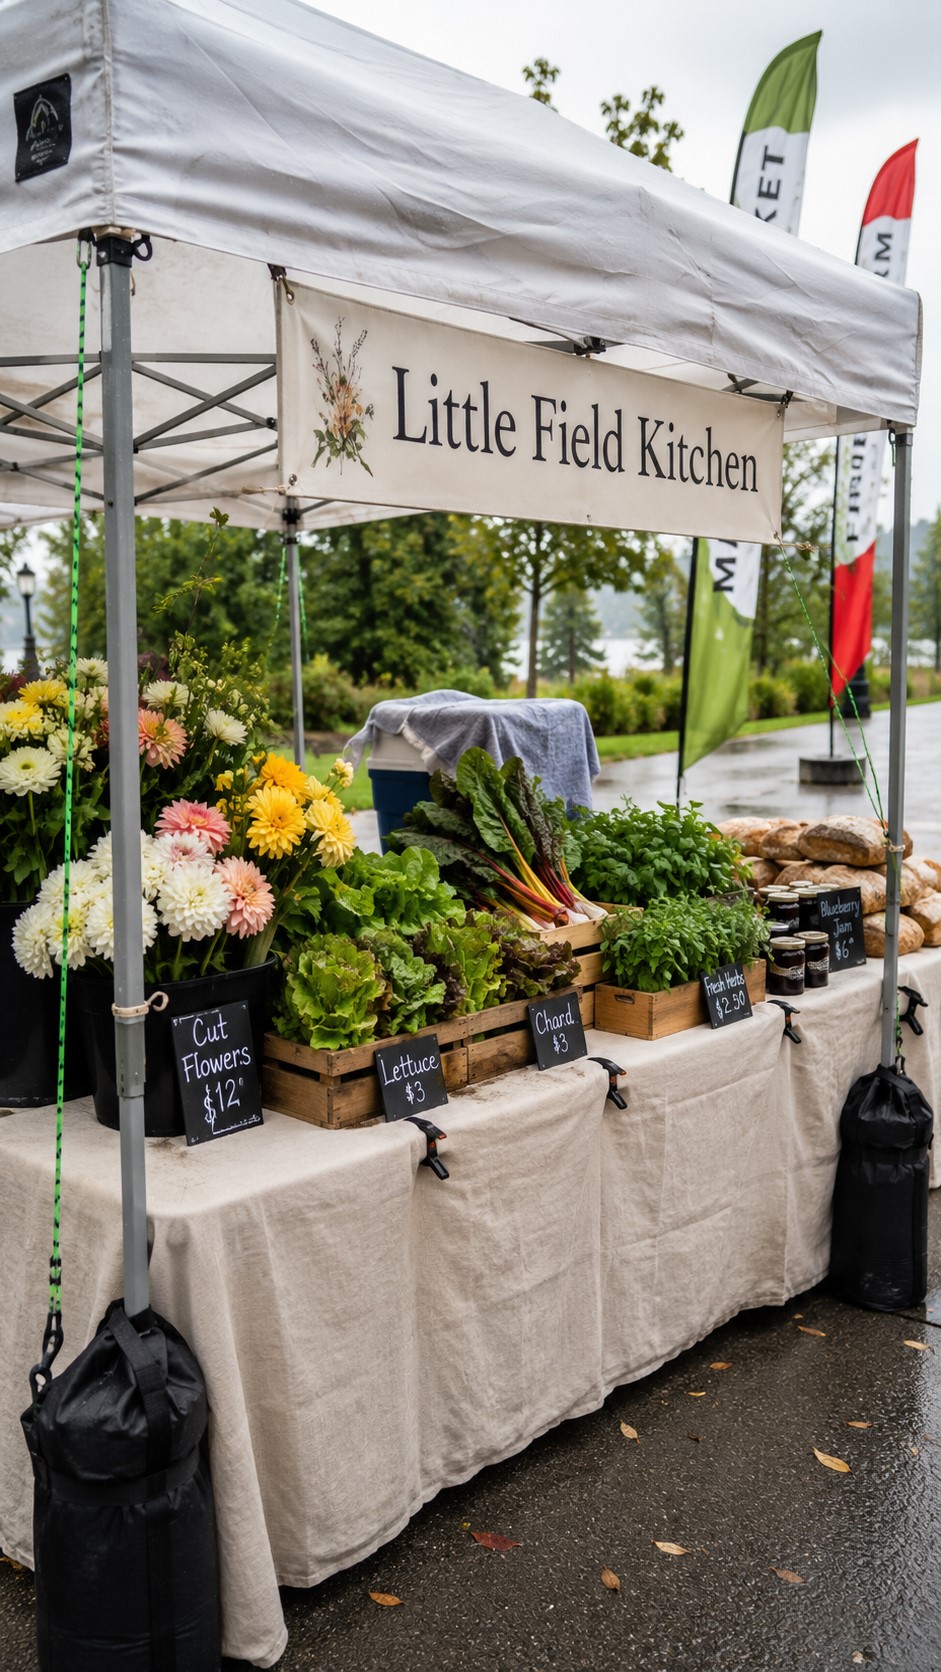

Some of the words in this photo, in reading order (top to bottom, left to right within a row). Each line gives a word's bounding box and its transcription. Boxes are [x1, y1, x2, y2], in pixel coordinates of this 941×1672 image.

[392, 366, 517, 458] Little
[531, 395, 626, 474] Field
[637, 416, 760, 493] Kitchen
[820, 895, 861, 918] Blueberry
[833, 918, 853, 938] Jam
[703, 973, 727, 997] Fresh
[724, 968, 746, 990] Herbs
[192, 1012, 229, 1047] Cut
[535, 1002, 575, 1035] Chard
[553, 1033, 569, 1055] $3
[181, 1046, 252, 1083] Flowers
[380, 1054, 440, 1086] Lettuce
[405, 1081, 426, 1105] $3
